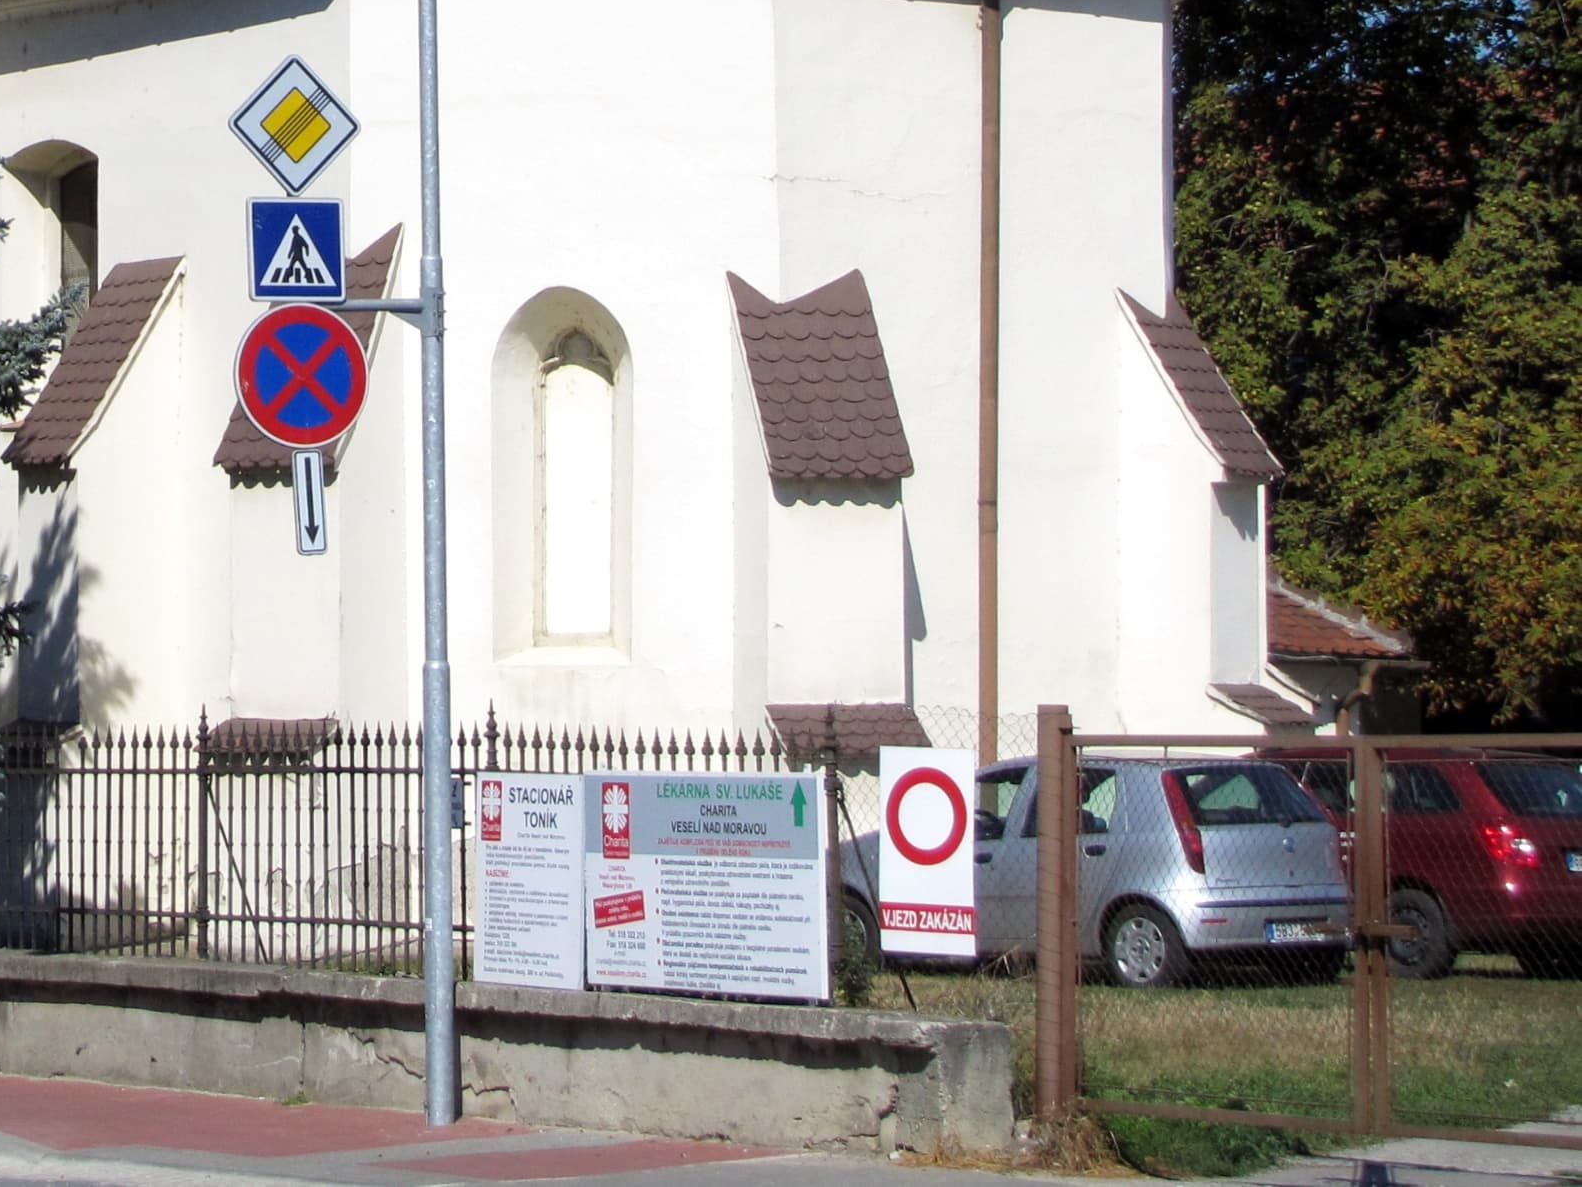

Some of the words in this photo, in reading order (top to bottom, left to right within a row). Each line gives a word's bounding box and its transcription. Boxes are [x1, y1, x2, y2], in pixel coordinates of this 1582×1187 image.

[508, 784, 574, 805] STACIONÁŘ
[656, 780, 710, 799] LÉKÁRNA
[716, 782, 733, 799] SV.
[736, 780, 784, 800] LUKÁŠE
[523, 807, 558, 829] TONÍK
[700, 804, 737, 817] CHARITA
[671, 819, 702, 834] VESELÍ
[703, 822, 722, 834] NAD
[723, 822, 767, 835] MORAVOU
[882, 908, 917, 927] VJEZD
[919, 908, 972, 931] ZAKÁZÁN
